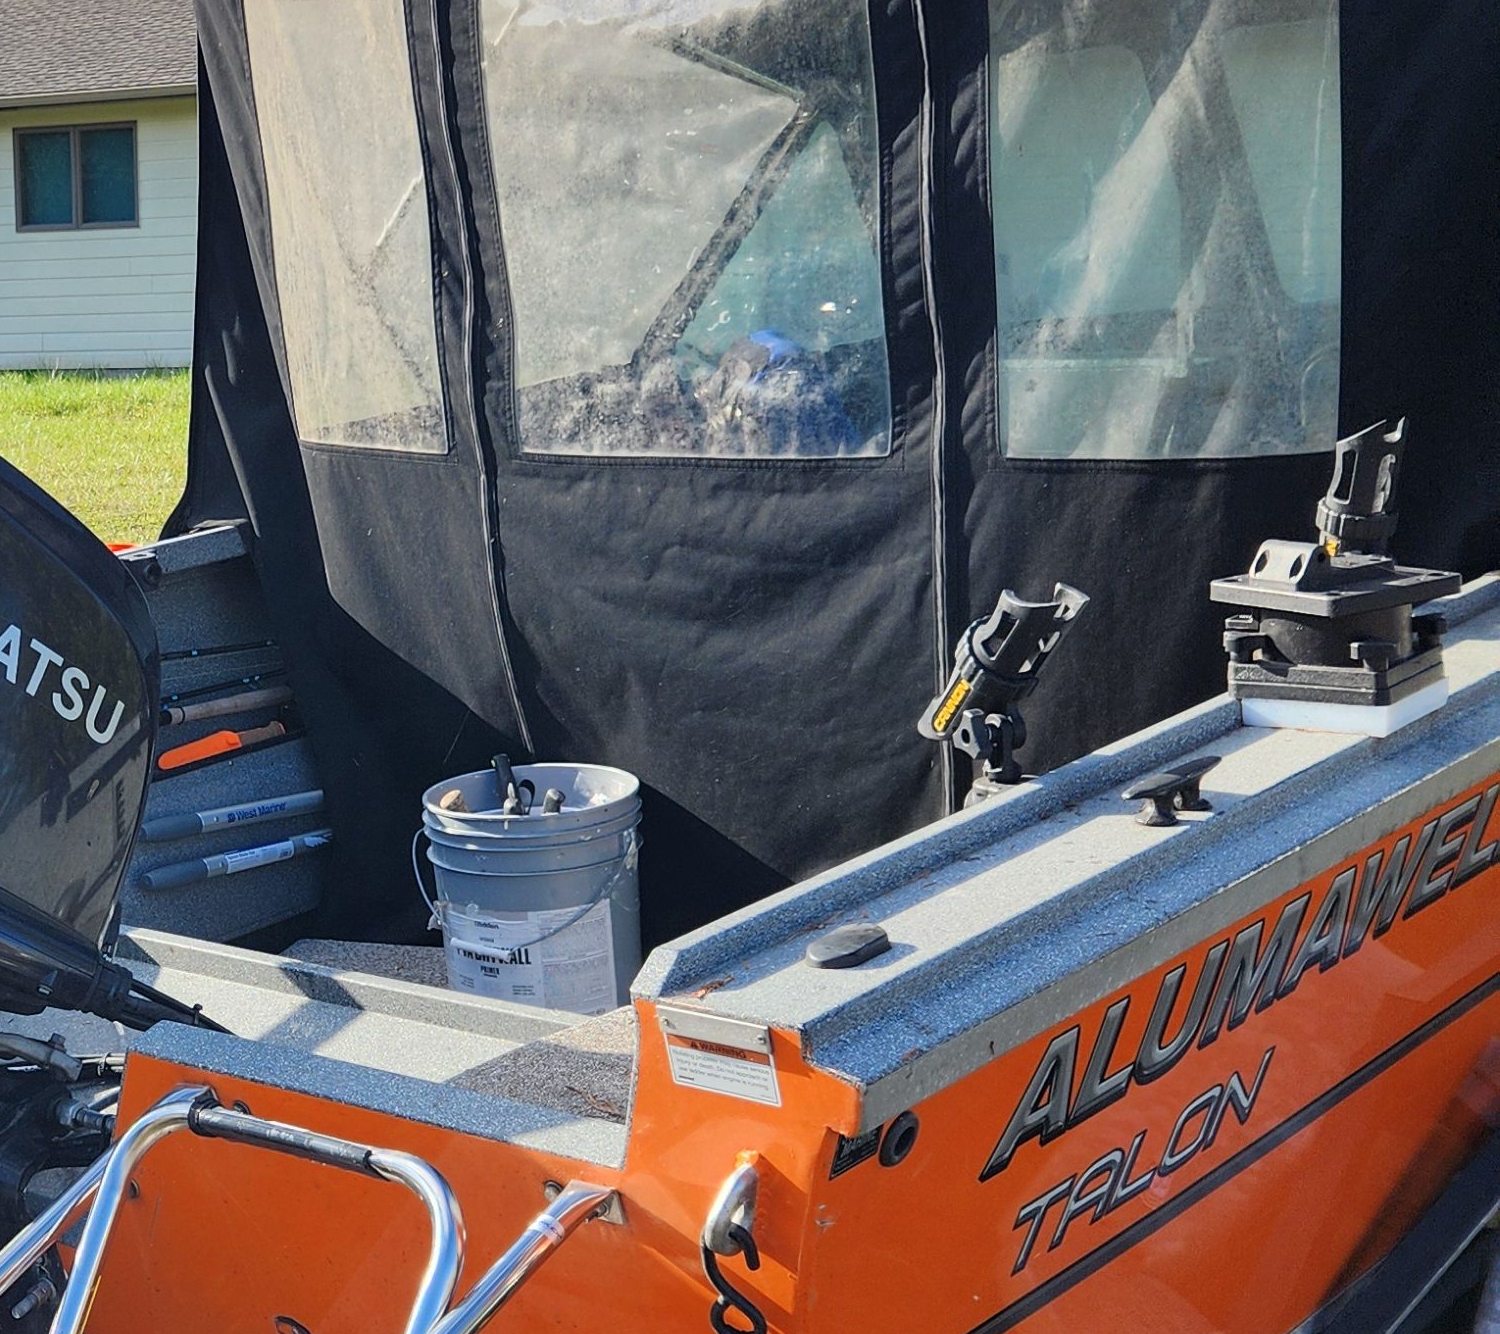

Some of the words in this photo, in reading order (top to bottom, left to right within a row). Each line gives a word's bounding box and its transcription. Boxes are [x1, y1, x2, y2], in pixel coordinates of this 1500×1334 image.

[933, 677, 970, 732] CANNON
[235, 808, 258, 821] West
[979, 782, 1500, 1182] ALUMAWEL
[699, 1042, 747, 1059] WARNING
[1011, 1046, 1276, 1277] TALON
